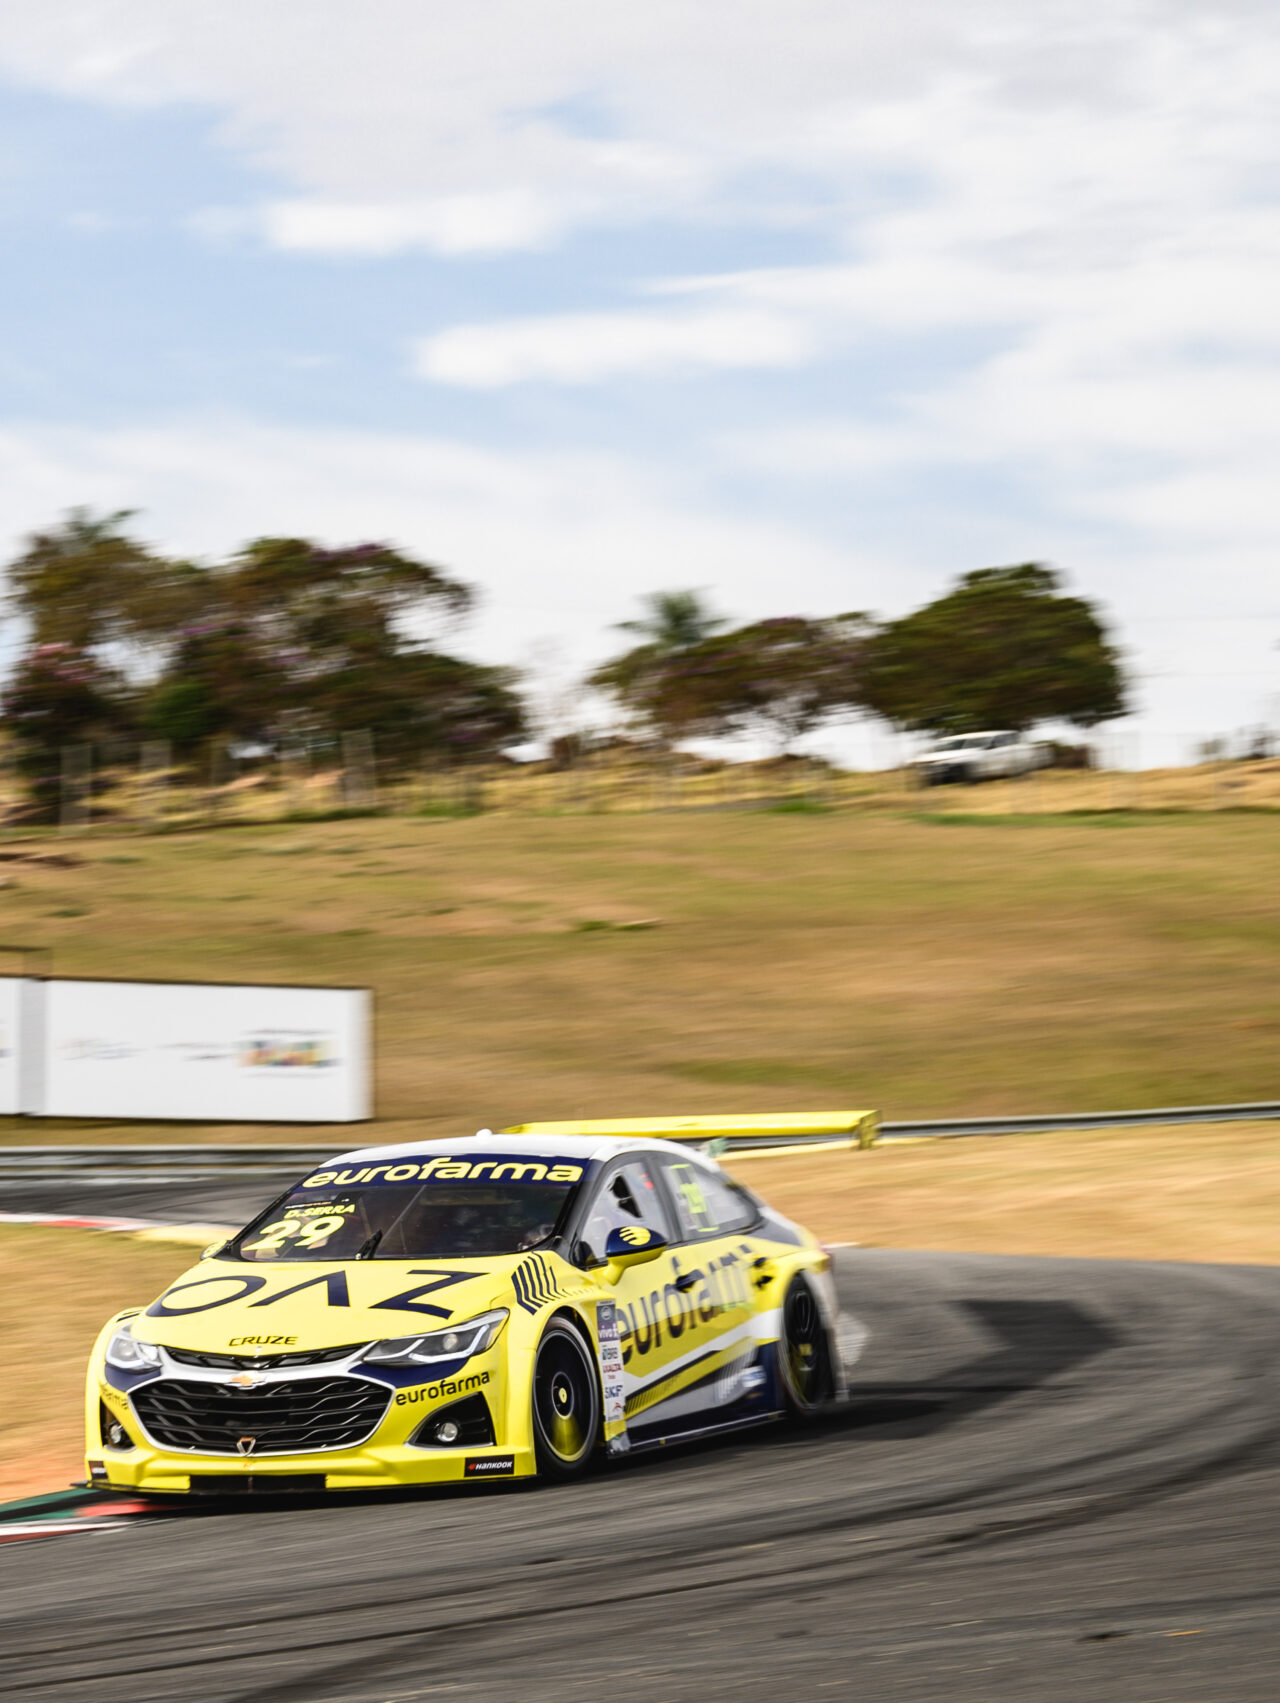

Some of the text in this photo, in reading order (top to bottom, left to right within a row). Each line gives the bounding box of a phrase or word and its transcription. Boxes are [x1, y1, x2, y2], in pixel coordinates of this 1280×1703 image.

[302, 1157, 584, 1188] eurofarma
[240, 1215, 345, 1251] 29
[229, 1336, 299, 1347] CRUZE
[395, 1371, 491, 1406] eurofarma
